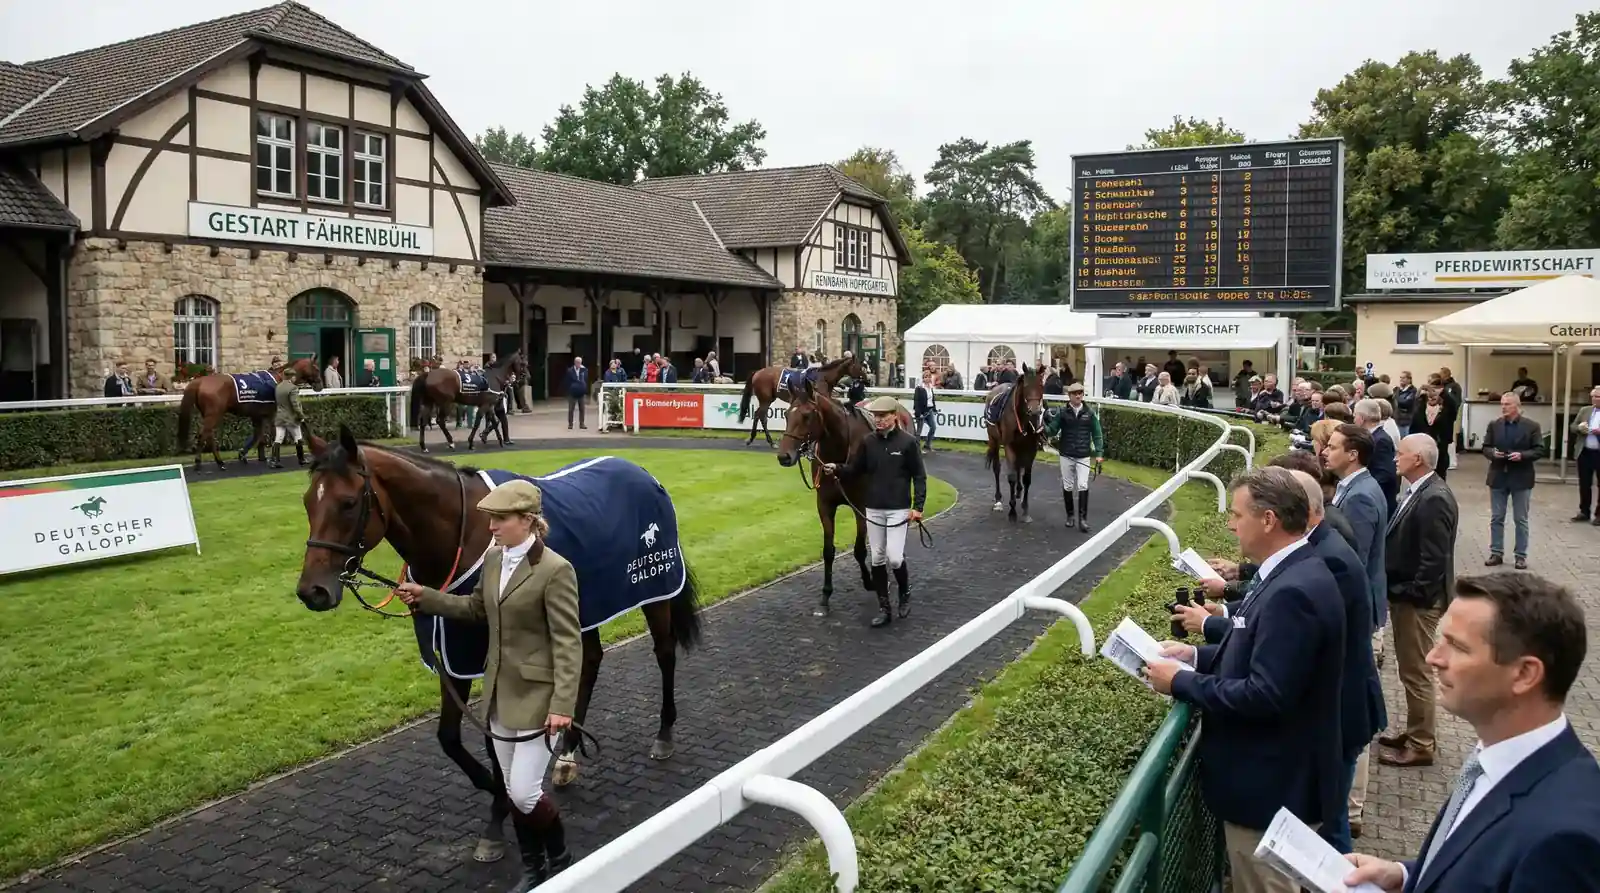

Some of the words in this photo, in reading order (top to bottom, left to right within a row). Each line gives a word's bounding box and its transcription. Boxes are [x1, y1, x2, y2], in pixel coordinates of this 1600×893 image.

[1181, 176, 1185, 184] 1
[1244, 172, 1251, 180] 2
[1244, 184, 1251, 192] 2
[1084, 202, 1089, 210] 3
[208, 212, 299, 239] GESTART
[307, 218, 421, 249] FÄHRENBÜHL
[1175, 244, 1186, 252] 12
[1435, 257, 1594, 273] PFERDEWIRTSCHAFT
[816, 275, 848, 288] RENNBAHN
[1137, 324, 1240, 334] PFERDEWIRTSCHAFT
[34, 518, 153, 543] DEUTSCHER
